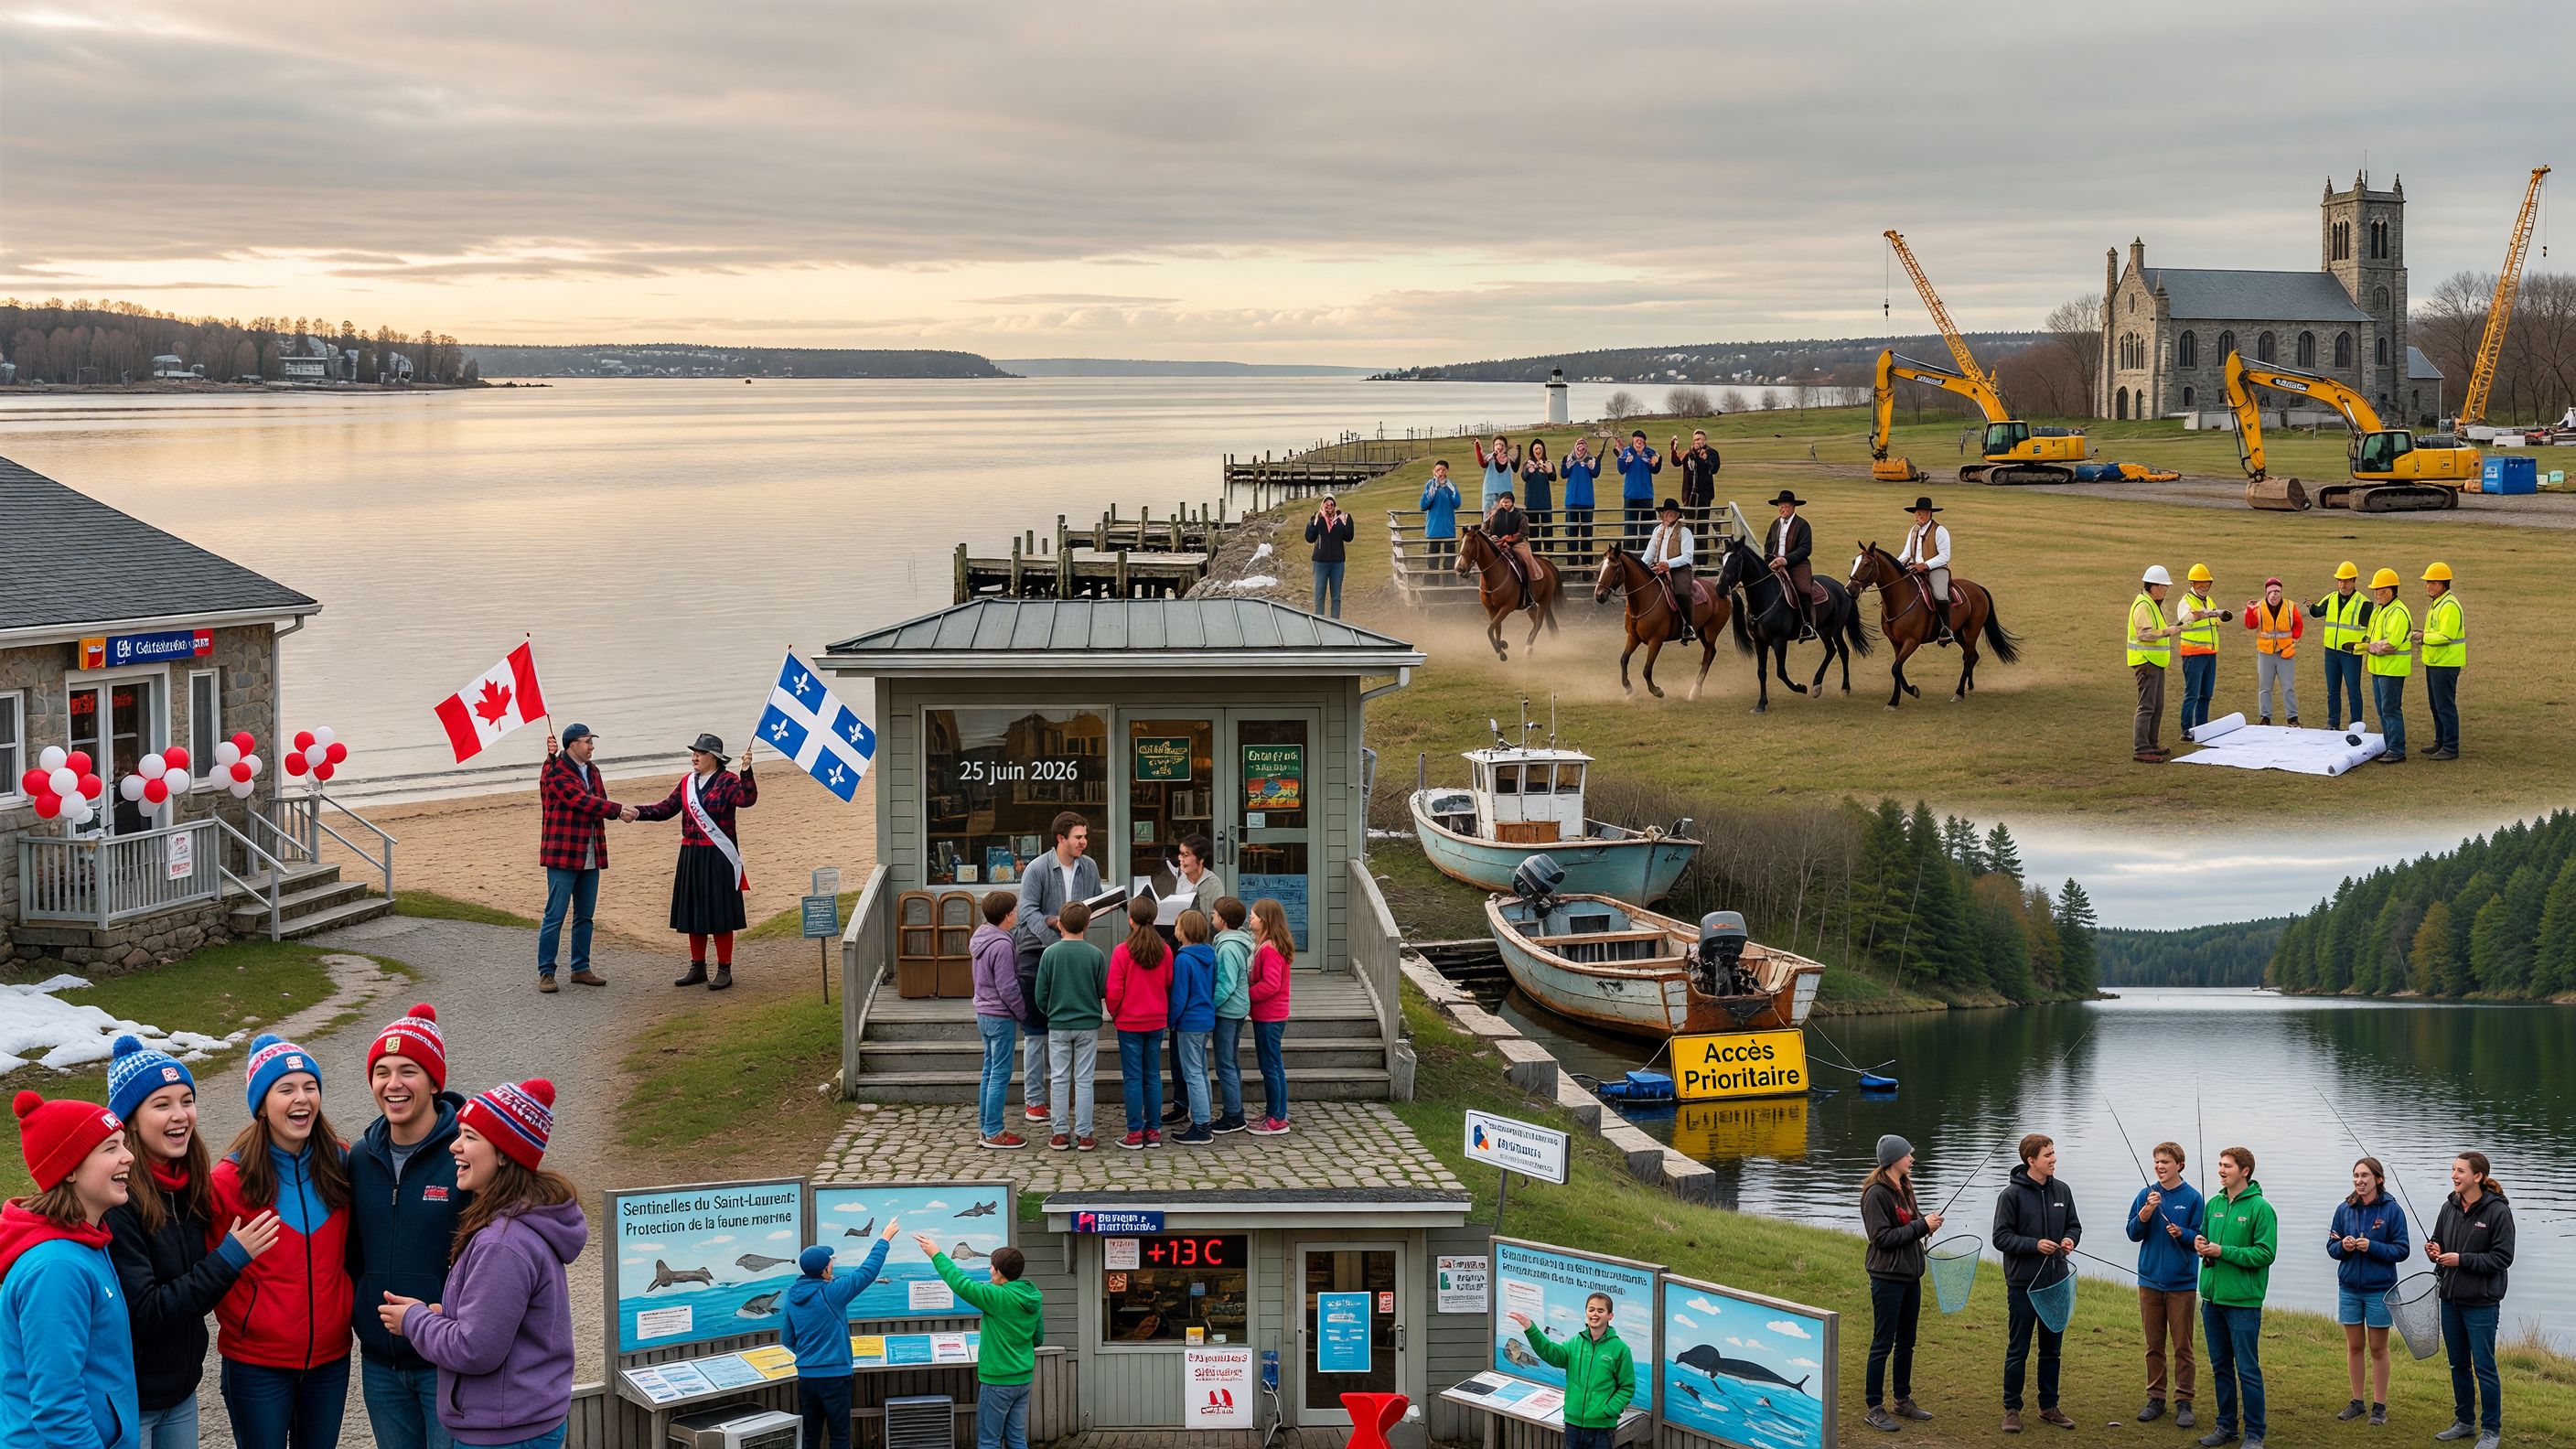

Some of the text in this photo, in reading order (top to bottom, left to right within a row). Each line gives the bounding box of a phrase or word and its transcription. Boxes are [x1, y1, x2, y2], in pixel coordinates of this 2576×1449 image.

[960, 760, 1078, 786] 25 juin 2026
[1703, 1039, 1775, 1063] Accès
[1684, 1066, 1799, 1091] Prioritaire
[623, 1198, 691, 1216] Sentinelles
[694, 1197, 710, 1210] du
[626, 1220, 685, 1236] Protection
[688, 1218, 703, 1230] de
[705, 1217, 714, 1229] la
[717, 1215, 749, 1228] faune
